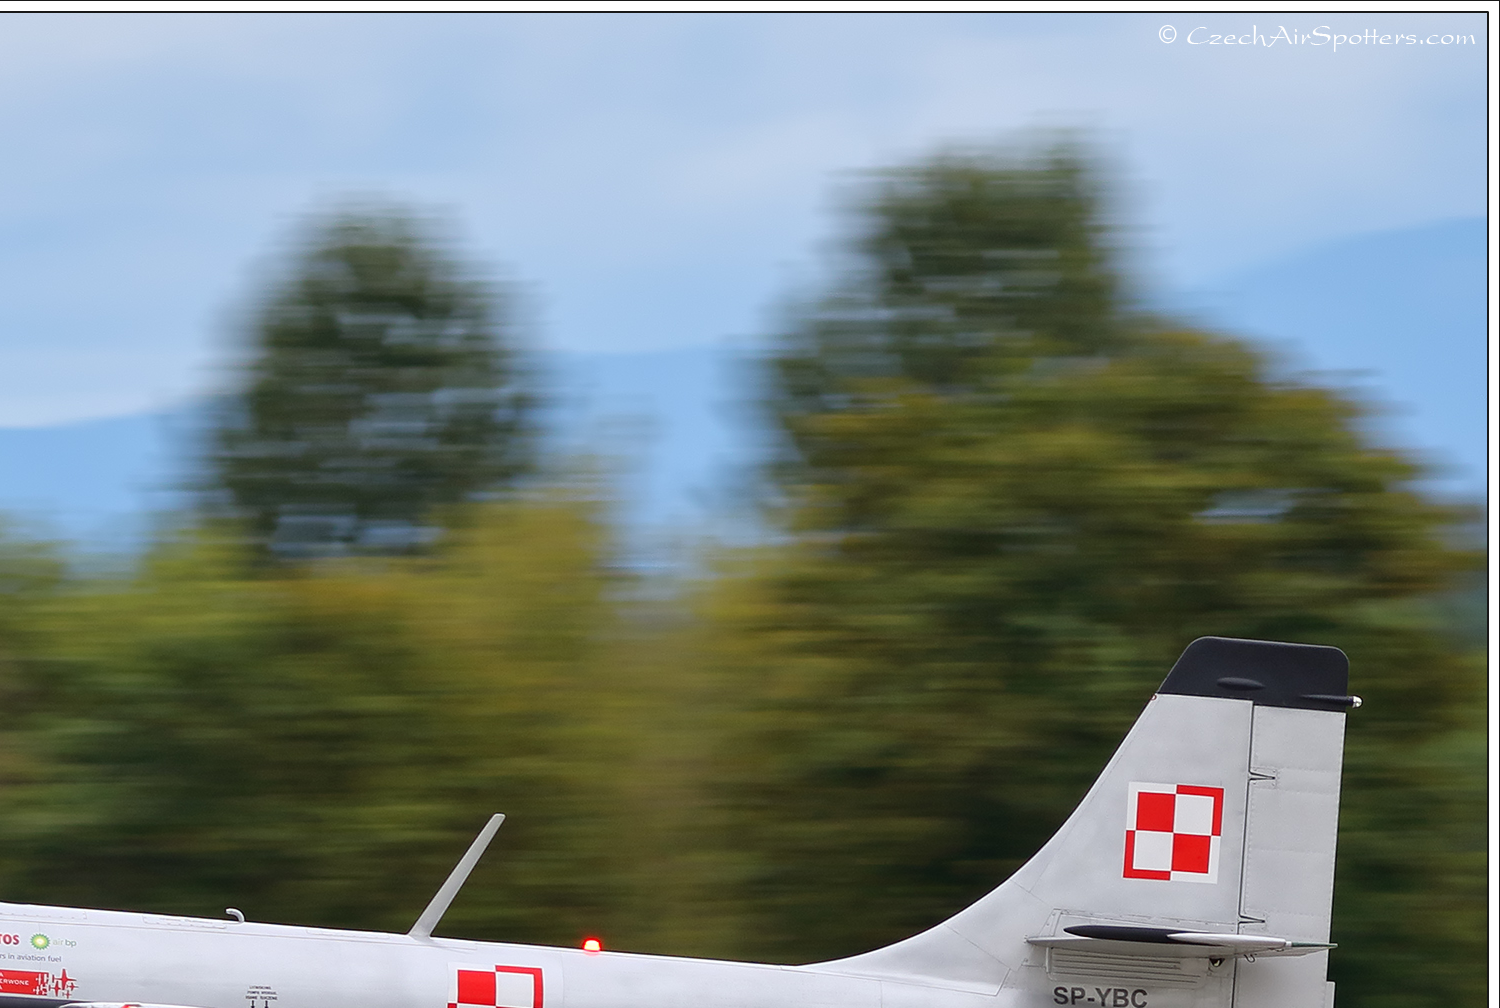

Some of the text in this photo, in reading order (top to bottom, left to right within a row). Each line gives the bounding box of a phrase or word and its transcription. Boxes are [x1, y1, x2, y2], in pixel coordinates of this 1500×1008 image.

[65, 939, 77, 948] bp
[17, 953, 46, 962] aviation
[47, 955, 62, 963] fuel
[1053, 986, 1148, 1008] SP-YBC
